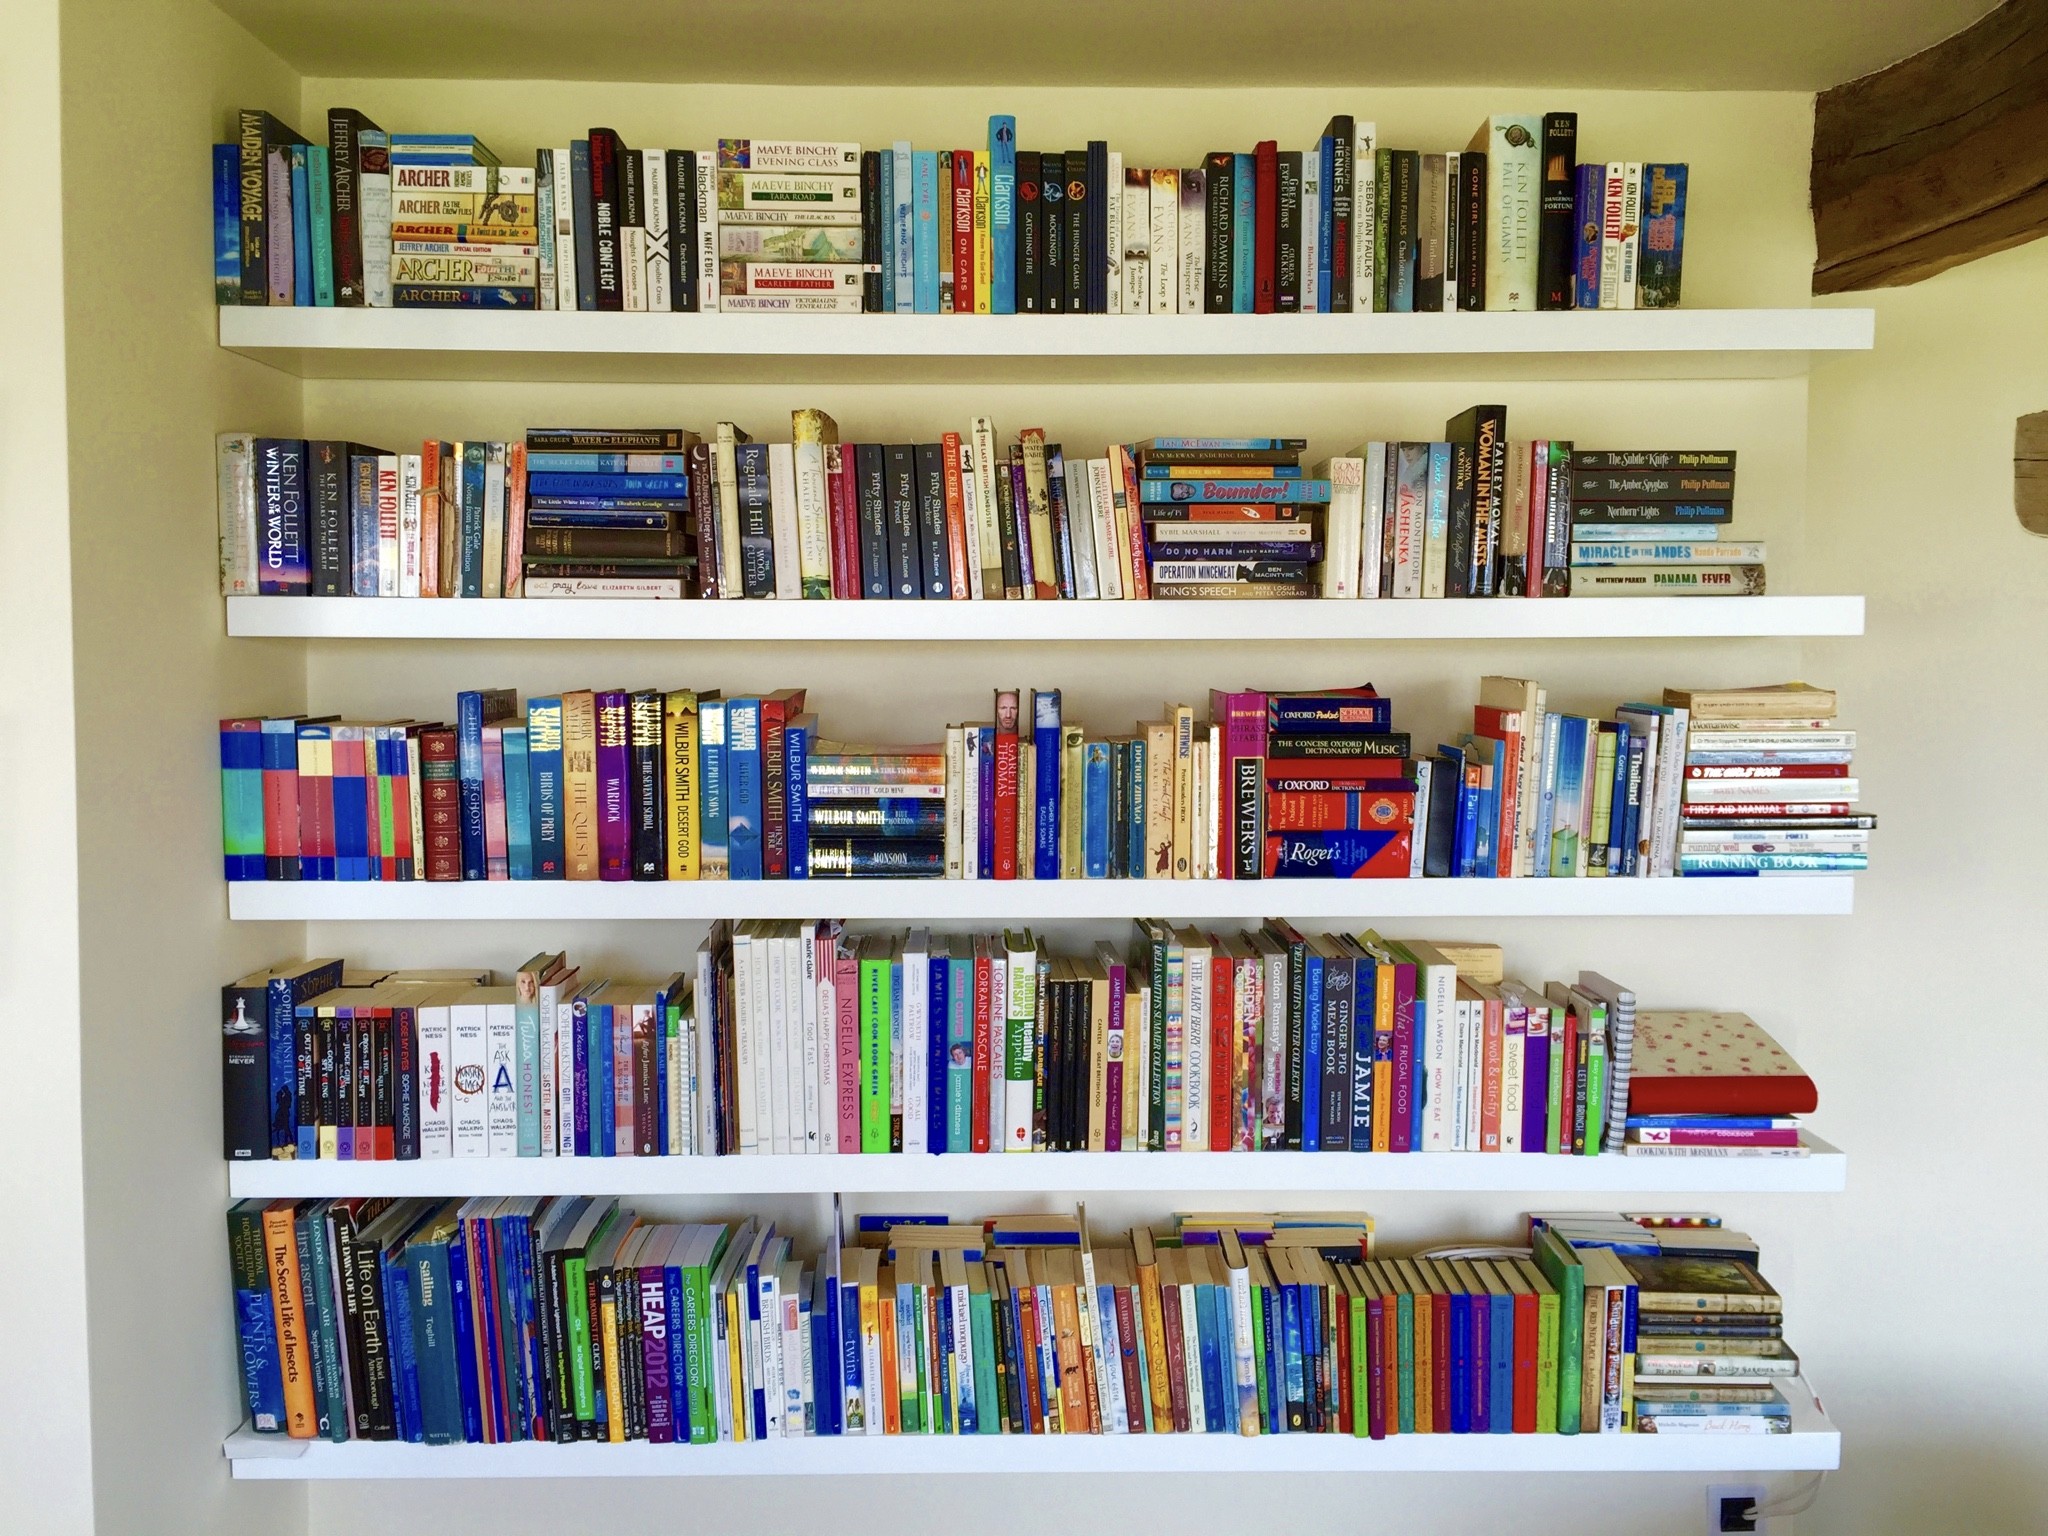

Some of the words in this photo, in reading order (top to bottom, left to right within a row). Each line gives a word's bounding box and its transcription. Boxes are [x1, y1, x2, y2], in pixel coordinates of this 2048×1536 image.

[240, 113, 261, 173] MAIDEN
[331, 118, 349, 166] JEFFREY
[757, 146, 796, 155] MAEVE
[799, 146, 838, 156] BINCHY
[398, 169, 450, 187] ARCHER
[757, 157, 798, 167] EVENING
[801, 157, 838, 167] CLASS
[1334, 138, 1344, 193] FIENNES
[243, 175, 263, 222] VOYAGE
[335, 167, 350, 211] ARCHER
[697, 166, 708, 223] blackman
[995, 175, 1014, 224] Clarkson
[1220, 176, 1228, 231] RICHARD
[1280, 164, 1289, 229] EXPECTATIONS
[1289, 178, 1299, 208] GREAT
[1608, 178, 1623, 199] KEN
[597, 203, 610, 230] NOBLE
[678, 193, 687, 233] BLACKMAN
[957, 188, 971, 232] Clarkson
[1606, 202, 1622, 239] FOLLETT
[704, 231, 712, 255] KNIFE
[960, 238, 967, 252] ON
[1025, 212, 1033, 251] CATCHING
[1049, 214, 1057, 267] MOCKINGJAY
[396, 258, 474, 282] ARCHER
[599, 234, 614, 291] CONFLICT
[704, 258, 713, 278] EDGE
[1220, 234, 1228, 289] DAWKINS
[573, 436, 601, 444] WATER
[611, 436, 660, 444] ELEPHANTS
[945, 434, 955, 448] UP
[266, 447, 280, 502] WINTER
[282, 452, 298, 486] KEN
[946, 450, 956, 470] THE
[1494, 442, 1504, 493] FARLEY
[1608, 453, 1622, 465] The
[1624, 453, 1645, 465] Subtle
[1648, 453, 1669, 466] Knife
[1679, 454, 1698, 466] Philip
[1699, 454, 1728, 465] Pullman
[740, 449, 758, 506] Reginald
[749, 509, 764, 536] Hill
[931, 472, 939, 497] Fifty
[948, 473, 958, 499] CREEK
[1203, 482, 1289, 499] Bounder!
[284, 488, 300, 562] FOLLETT
[932, 500, 941, 535] Shades
[1490, 496, 1501, 547] MOWAT
[267, 516, 282, 568] WORLD
[1166, 548, 1179, 556] DO
[1185, 548, 1200, 556] NO
[1579, 546, 1631, 559] MIRACLE
[1654, 545, 1691, 558] ANDES
[1159, 565, 1197, 579] OPERATION
[1198, 565, 1235, 579] MINCEMEAT
[1654, 574, 1697, 585] PANAMA
[1702, 573, 1731, 585] FEVER
[1163, 586, 1197, 596] KING'S
[1199, 586, 1237, 596] SPEECH
[1284, 711, 1315, 719] OXFORD
[1316, 710, 1339, 720] Pocket
[674, 722, 688, 767] WILBUR
[1278, 740, 1294, 748] THE
[1296, 740, 1328, 748] CONCISE
[1305, 747, 1345, 755] DICTIONARY
[998, 743, 1008, 798] THOMAS
[1008, 743, 1017, 796] GARETH
[1134, 745, 1142, 782] DOCTOR
[1617, 754, 1626, 781] Corsica
[1628, 752, 1642, 806] Thailand
[607, 778, 620, 823] WARLOCK
[676, 769, 690, 802] SMITH
[1134, 783, 1142, 824] ZHIVAGO
[1284, 780, 1329, 791] OXFORD
[679, 806, 689, 839] DESERT
[1240, 764, 1257, 855] BREWER'S
[1689, 805, 1718, 814] FIRST
[1719, 805, 1737, 814] AID
[1738, 805, 1781, 814] MANUAL
[680, 841, 689, 858] GOD
[1291, 842, 1342, 861] Roget's
[1699, 856, 1768, 869] RUNNING
[1773, 855, 1820, 868] BOOK
[281, 989, 292, 1027] SOPHIE
[978, 966, 988, 1020] LORRAINE
[1013, 967, 1024, 1018] RAMSAY'S
[1024, 975, 1034, 1017] GORDON
[841, 998, 853, 1056] NIGELLA
[1327, 1001, 1336, 1031] MEAT
[1339, 1000, 1348, 1051] GINGER
[282, 1034, 293, 1084] KINSELLA
[977, 1024, 987, 1071] PASCALE
[1013, 1024, 1025, 1078] Appetite
[1023, 1021, 1033, 1062] Healthy
[1326, 1033, 1335, 1075] BOOK
[1489, 1040, 1497, 1065] wok
[1338, 1052, 1347, 1075] PIG
[1399, 1045, 1408, 1084] FRUGAL
[1488, 1068, 1496, 1077] &
[1508, 1043, 1518, 1080] sweet
[402, 1073, 410, 1096] SOPHIE
[842, 1062, 854, 1120] EXPRESS
[1354, 1052, 1371, 1128] JAMIE
[1398, 1086, 1407, 1115] FOOD
[1484, 1079, 1499, 1118] stir-fry
[1507, 1082, 1519, 1112] food
[403, 1097, 411, 1140] McKENZIE
[274, 1244, 287, 1267] The
[357, 1250, 374, 1285] Life
[276, 1267, 289, 1303] Secret
[361, 1287, 374, 1310] on
[420, 1260, 433, 1307] Sailing
[280, 1303, 295, 1329] Life
[685, 1287, 696, 1332] CAREERS
[762, 1299, 770, 1334] BRITISH
[283, 1329, 296, 1341] of
[363, 1309, 383, 1354] Earth
[425, 1316, 435, 1348] Toghill
[763, 1335, 771, 1364] BIRDS
[958, 1328, 968, 1364] morpurgo
[243, 1334, 262, 1409] FLOWERS
[285, 1341, 299, 1383] Insects
[688, 1333, 701, 1388] DIRECTORY
[845, 1339, 857, 1381] twins
